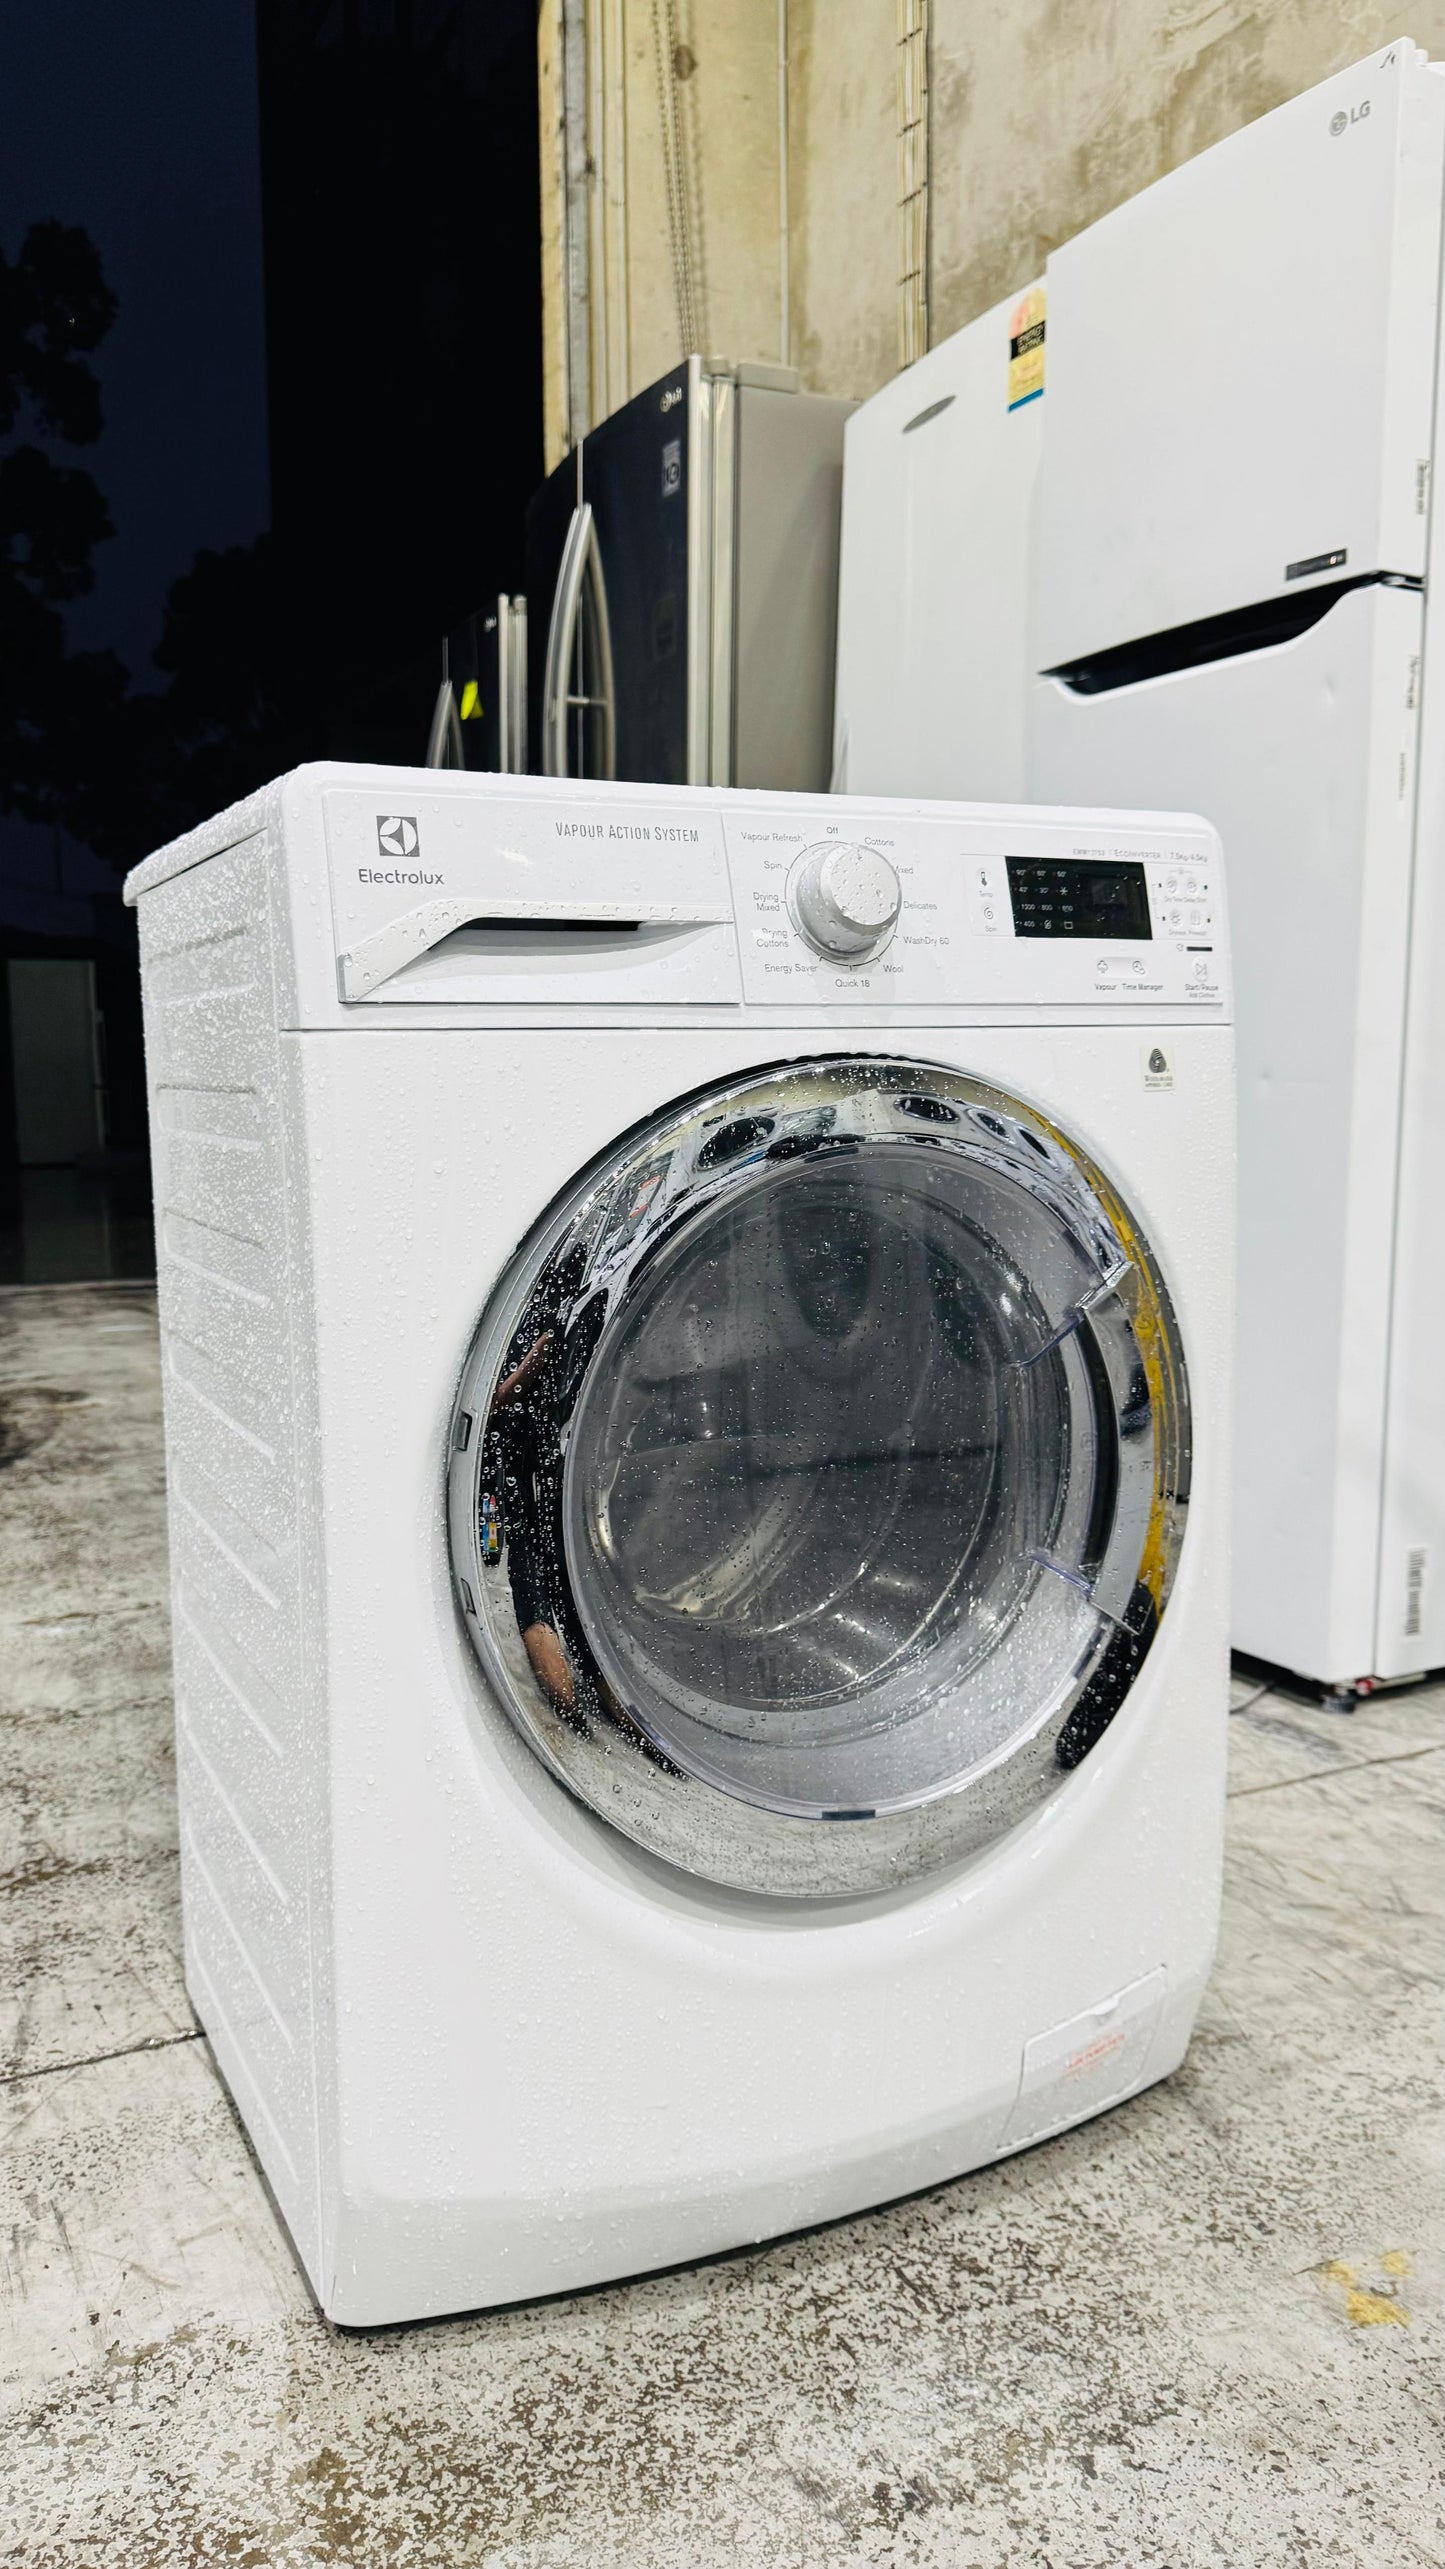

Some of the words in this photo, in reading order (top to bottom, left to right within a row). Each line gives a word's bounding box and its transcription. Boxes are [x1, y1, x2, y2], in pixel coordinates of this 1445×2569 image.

[1350, 100, 1371, 124] LG
[555, 822, 604, 838] VAPOUR
[608, 825, 650, 840] ACTION
[654, 826, 699, 842] SYSTEM
[826, 826, 839, 835] Off
[741, 832, 770, 842] Vapour
[772, 833, 803, 842] Refresh
[864, 837, 895, 847] Cottons
[763, 860, 782, 870] Spin
[358, 868, 444, 885] Electrolux
[753, 892, 779, 903] Drying
[756, 902, 780, 912] Mixed
[903, 901, 938, 910] Delicates
[761, 928, 788, 939] Drying
[756, 939, 789, 948] Cottons
[903, 936, 937, 946] WashDry
[939, 937, 950, 945] 60
[764, 964, 793, 975] Energy
[794, 964, 818, 972] Saver
[883, 964, 904, 973] Wool
[835, 979, 858, 989] Quick
[860, 979, 870, 987] 18
[1094, 983, 1117, 991] Vapour
[1138, 983, 1164, 991] Manager
